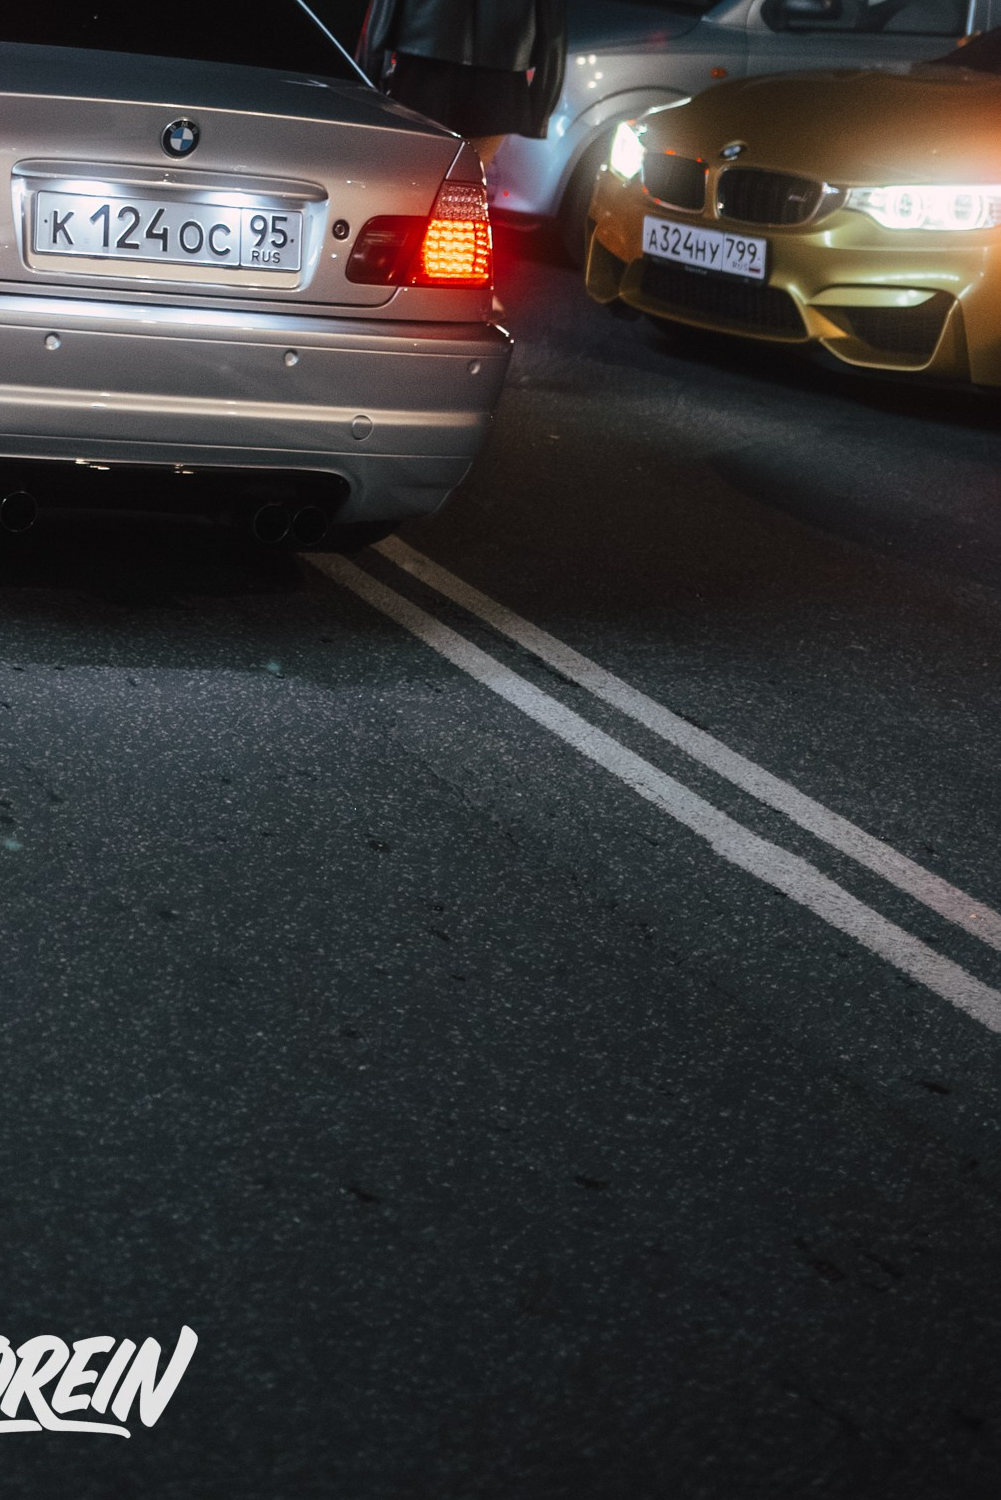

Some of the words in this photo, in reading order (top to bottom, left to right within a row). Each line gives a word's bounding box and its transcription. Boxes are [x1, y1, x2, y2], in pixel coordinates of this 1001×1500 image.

[249, 214, 288, 249] 95
[251, 249, 281, 264] RUS
[725, 238, 758, 264] 799
